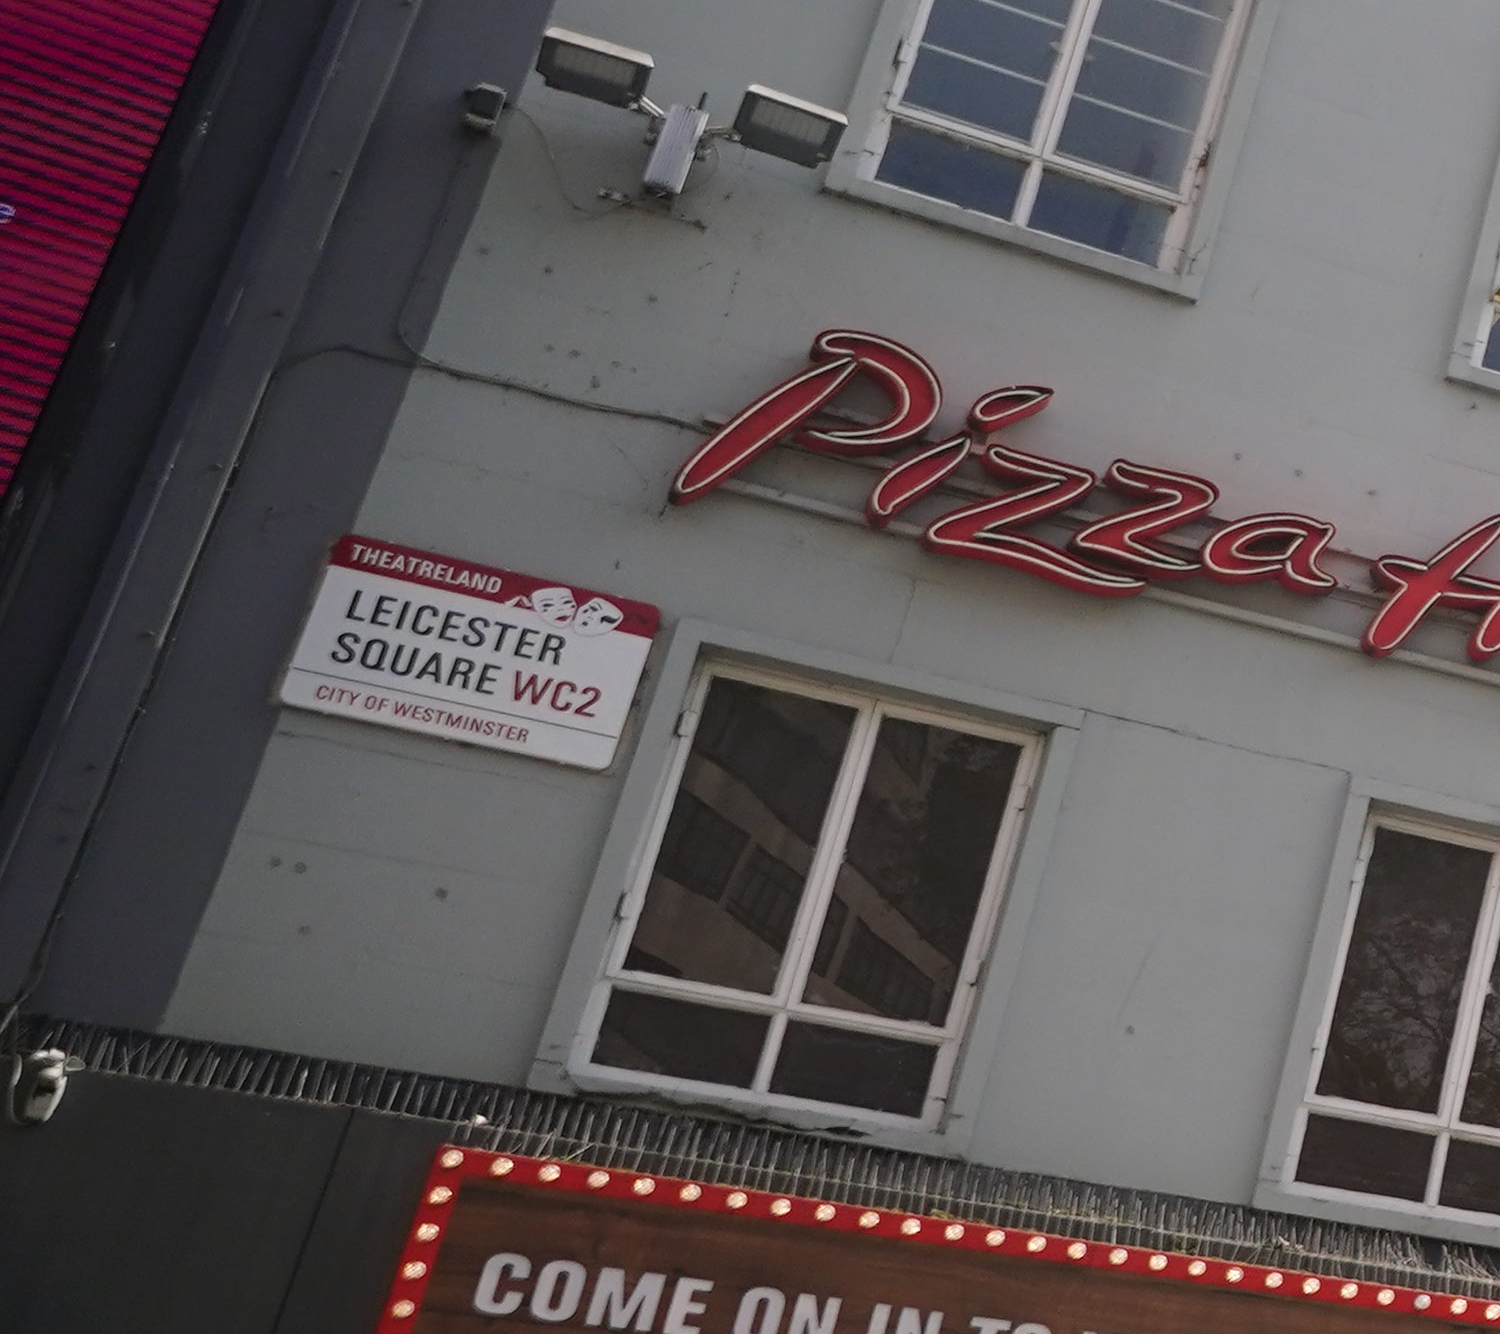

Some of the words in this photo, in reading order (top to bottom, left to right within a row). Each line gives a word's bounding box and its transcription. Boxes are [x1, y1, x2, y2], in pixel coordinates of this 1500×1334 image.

[668, 328, 1338, 597] Pizza
[351, 543, 503, 595] THEATRELAND
[345, 589, 568, 666] LEICESTER
[314, 684, 358, 705] CITY
[364, 694, 389, 713] OF
[395, 702, 529, 743] WESTMINSTER
[330, 632, 503, 695] SQUARE
[510, 670, 602, 718] WC2
